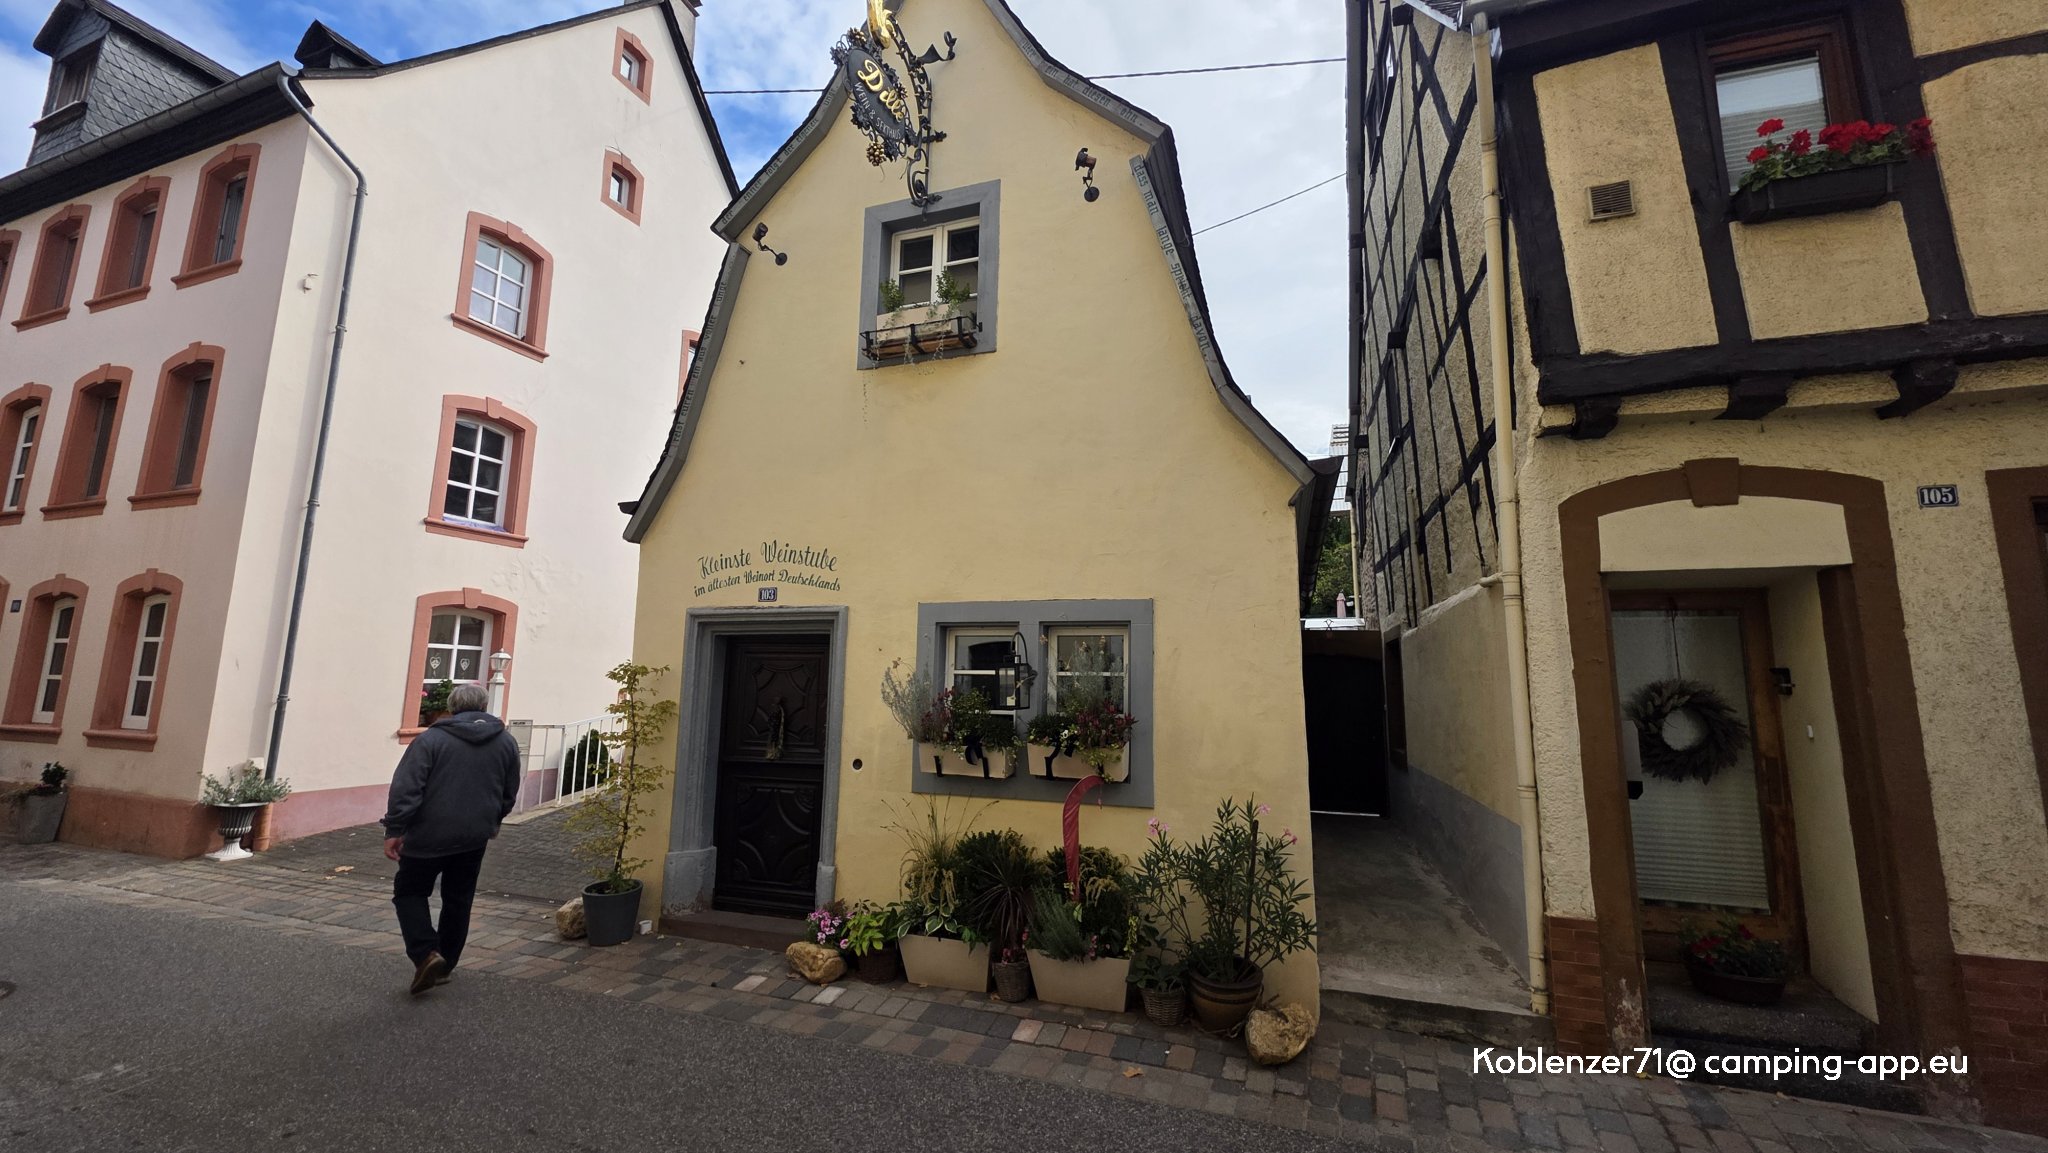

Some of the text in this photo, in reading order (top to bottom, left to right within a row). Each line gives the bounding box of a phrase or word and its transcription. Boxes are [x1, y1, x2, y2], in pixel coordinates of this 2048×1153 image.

[741, 179, 763, 204] enner
[1134, 162, 1148, 187] dass
[1144, 190, 1159, 216] man
[1156, 226, 1175, 256] lange
[1921, 487, 1953, 504] 105
[698, 540, 838, 580] Kleinste Weinstube
[694, 569, 841, 597] im ältesten Weinort Deutschlands
[761, 589, 774, 600] 103
